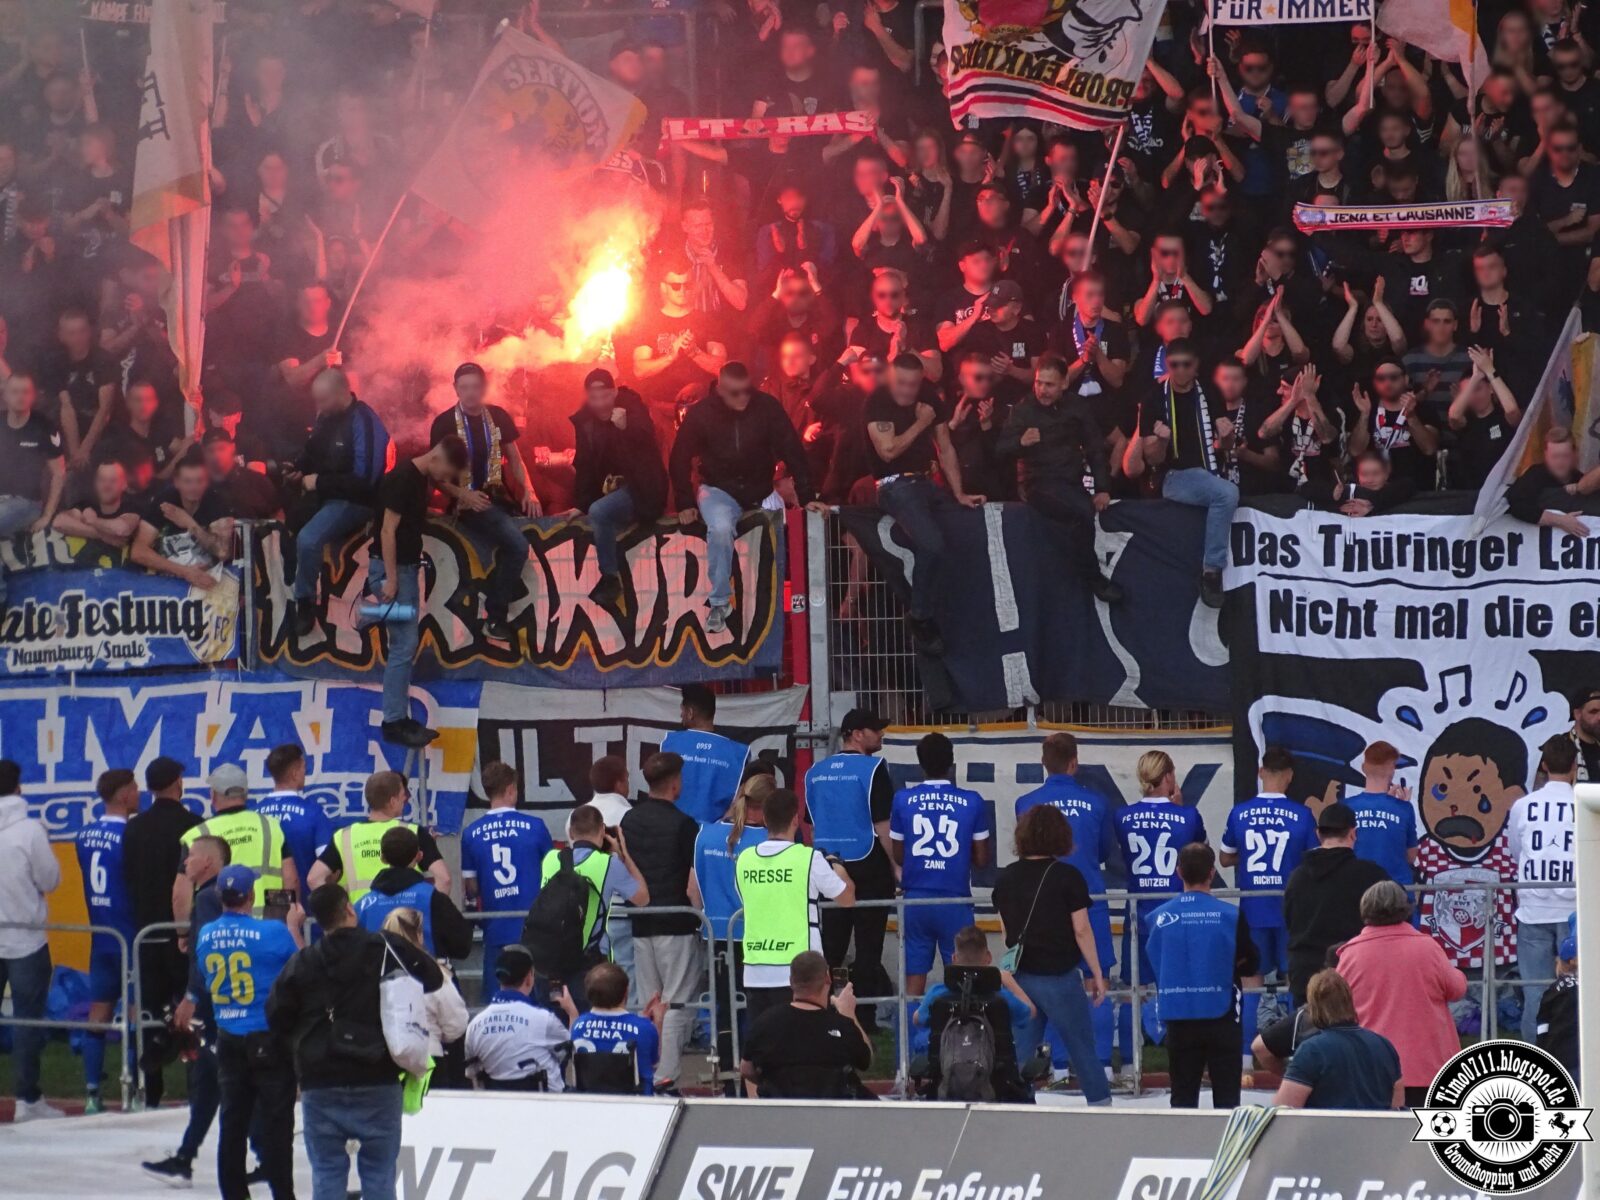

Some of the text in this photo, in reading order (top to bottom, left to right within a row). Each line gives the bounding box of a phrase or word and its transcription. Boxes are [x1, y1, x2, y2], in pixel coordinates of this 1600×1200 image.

[1213, 0, 1371, 19] FÜR IMMER
[1330, 206, 1475, 223] JENA ET LAUSANNE
[1230, 522, 1301, 569] Das
[1318, 524, 1524, 579] Thüringer
[60, 594, 209, 641] Festung
[1269, 588, 1378, 640] Nicht
[1394, 598, 1468, 640] mal
[1484, 595, 1553, 639] die
[214, 616, 229, 643] FC
[696, 742, 712, 750] 0959
[907, 792, 968, 806] FC CARL ZEISS
[1067, 799, 1092, 811] ZEISS
[260, 804, 305, 816] CARL ZEISS
[918, 802, 955, 812] JENA
[1122, 811, 1186, 824] FC CARL ZEISS
[1239, 807, 1299, 822] FC CARL ZEISS
[1376, 810, 1400, 824] ZEISS
[472, 819, 531, 838] FC CARL ZEISS
[1132, 820, 1171, 830] JENA
[1249, 817, 1285, 827] JENA
[483, 828, 519, 841] JENA
[912, 813, 960, 858] 23
[83, 838, 112, 850] JENA
[1245, 828, 1290, 872] 27
[361, 849, 381, 858] ORDN
[1127, 832, 1178, 876] 26
[492, 843, 517, 885] 3
[924, 860, 946, 870] ZANK
[1524, 859, 1574, 882] FLIGH
[90, 850, 107, 894] 6
[743, 868, 793, 883] PRESSE
[1138, 877, 1170, 888] BUTZEN
[1253, 875, 1283, 885] RICHTER
[202, 927, 261, 942] FC CARL ZEISS
[211, 938, 246, 949] JENA
[746, 939, 795, 951] saller
[205, 951, 255, 1005] 26
[484, 1014, 503, 1026] CARL
[505, 1013, 529, 1027] ZEISS
[574, 1019, 639, 1035] FC CARL ZEISS
[482, 1024, 516, 1036] JENA
[583, 1029, 623, 1040] JENA
[521, 1149, 638, 1200] AG
[696, 1163, 795, 1200] SWE
